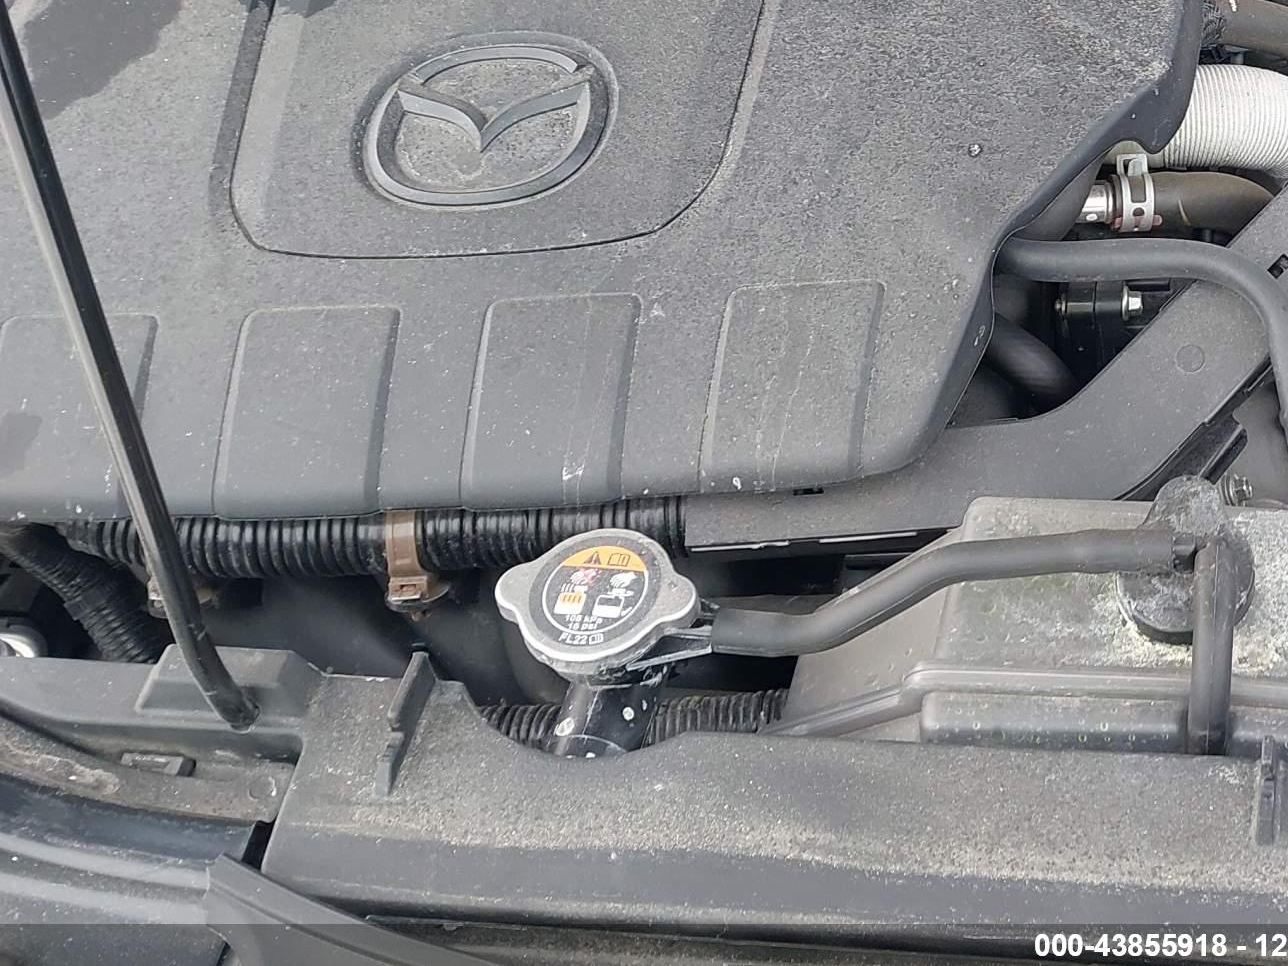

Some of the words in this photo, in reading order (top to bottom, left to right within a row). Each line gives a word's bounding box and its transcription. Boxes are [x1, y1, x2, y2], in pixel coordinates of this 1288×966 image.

[583, 615, 603, 624] kPa
[580, 623, 598, 631] psi
[558, 632, 588, 645] FL22
